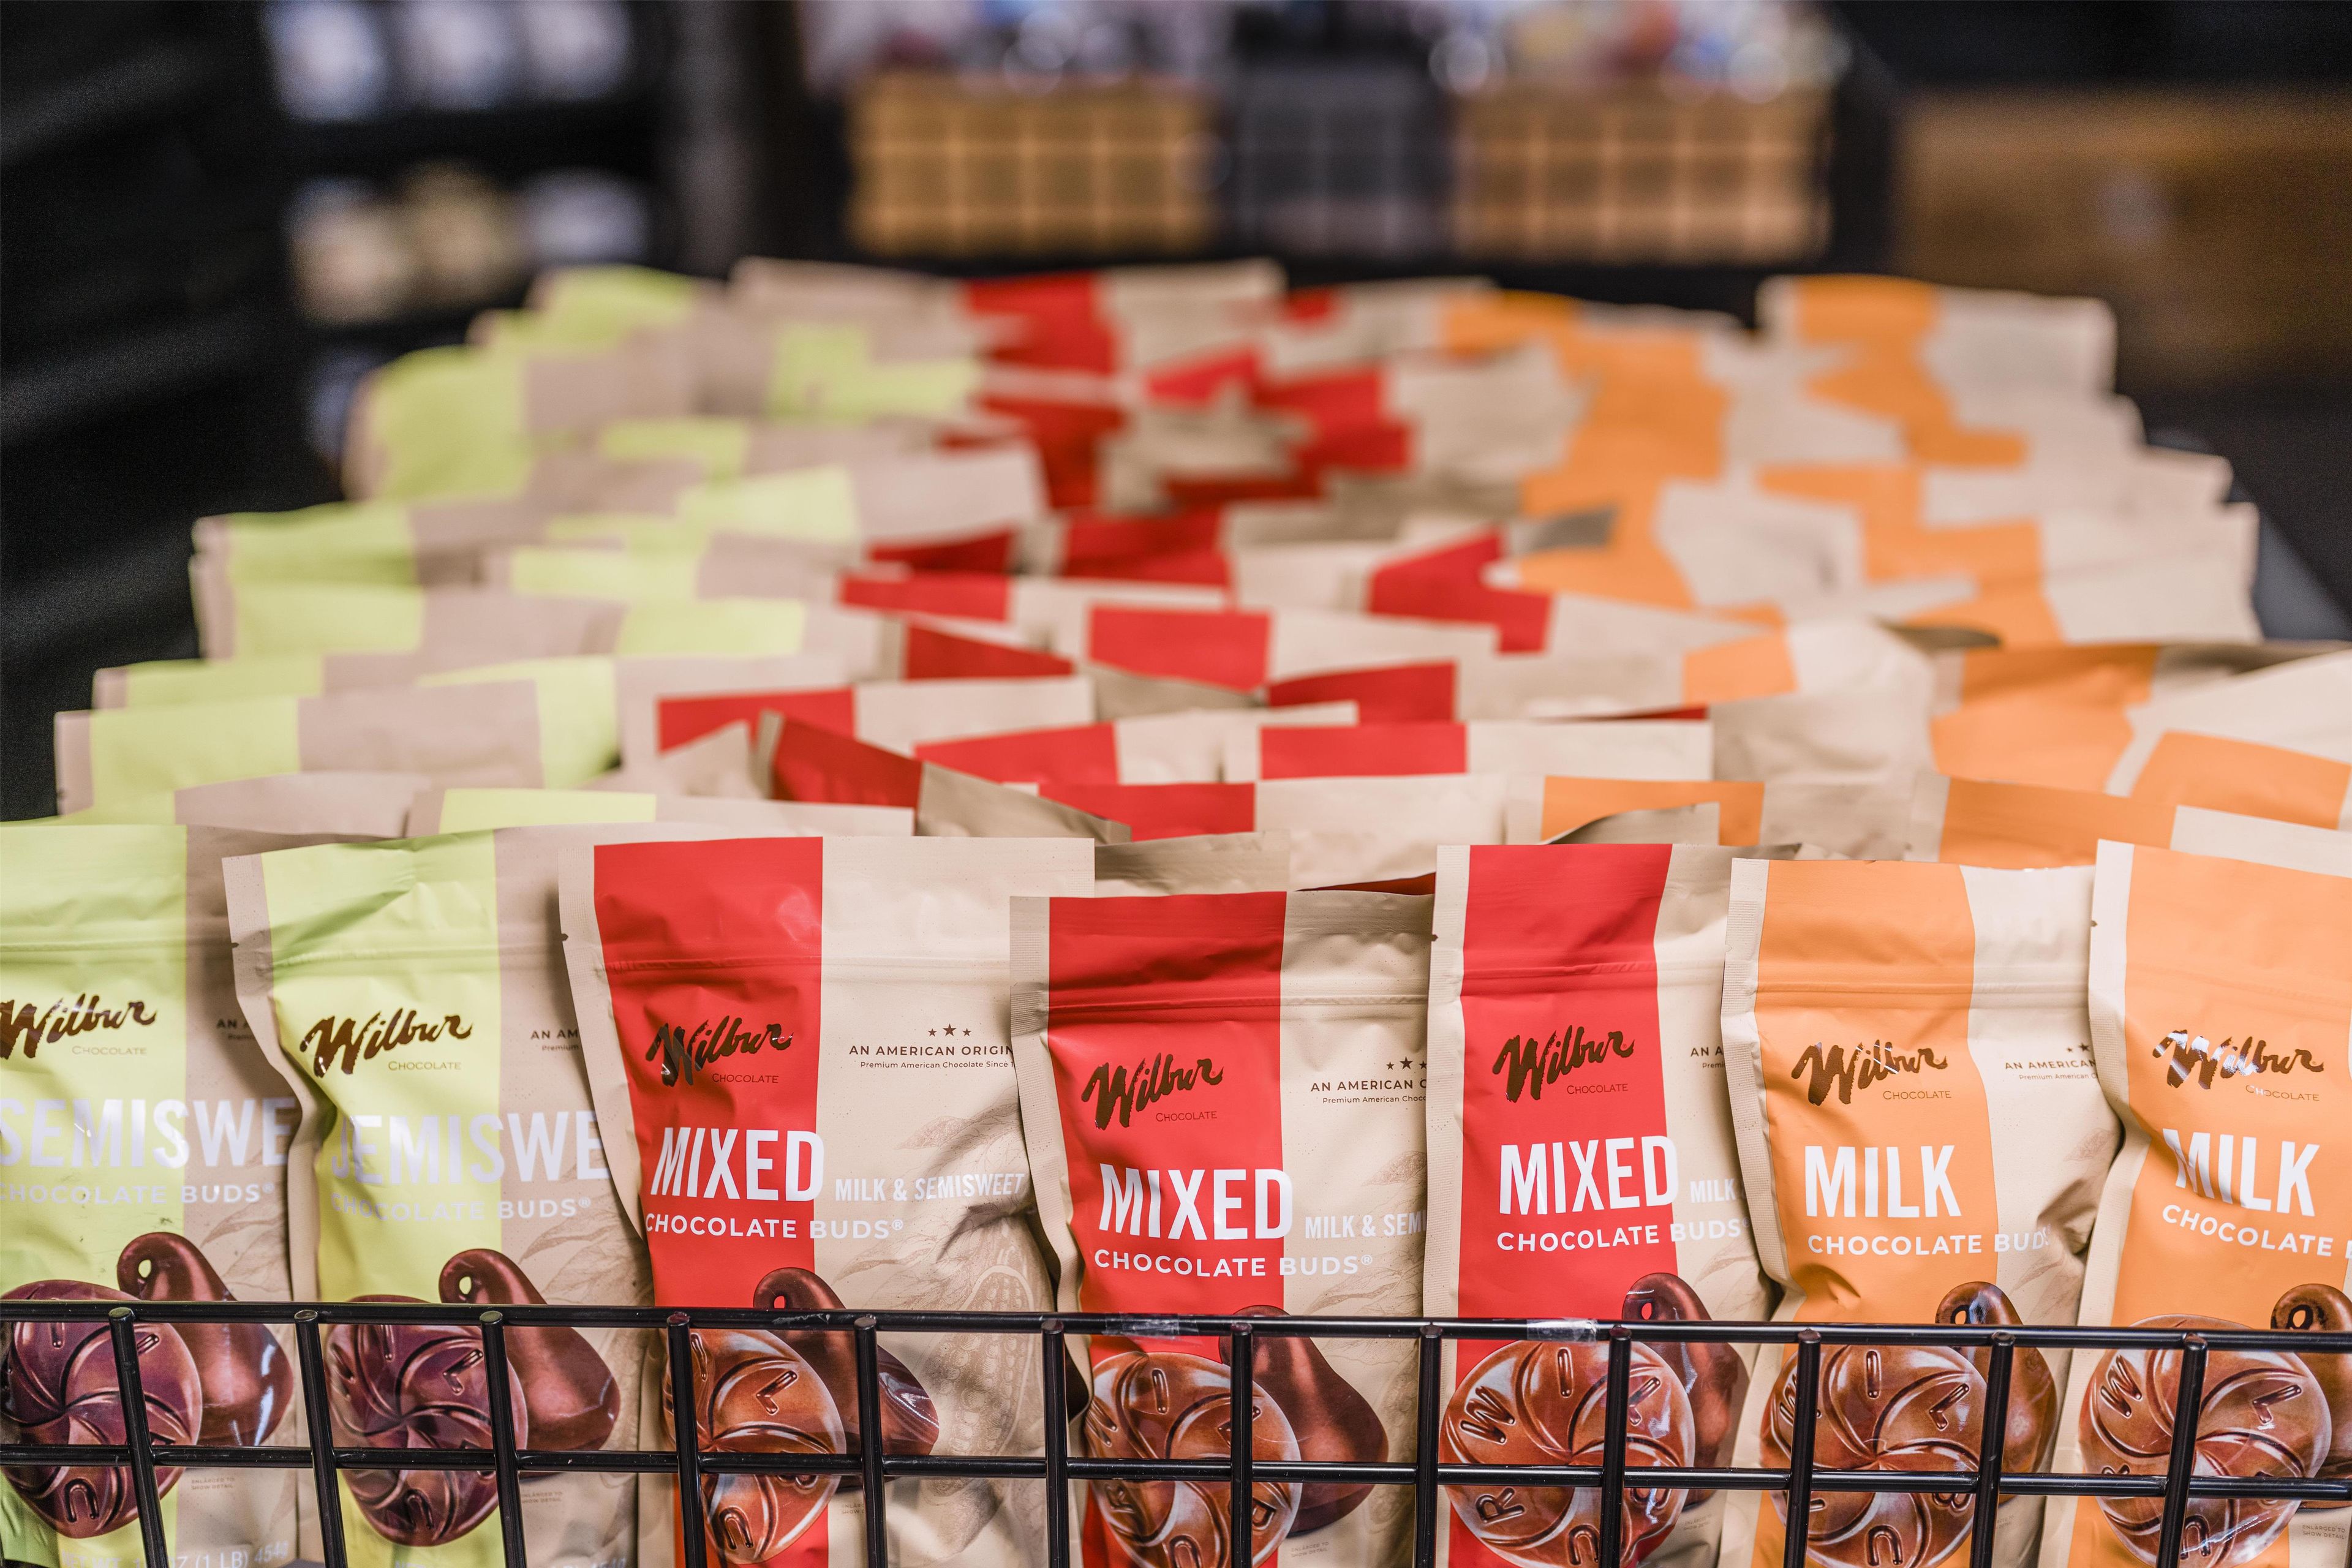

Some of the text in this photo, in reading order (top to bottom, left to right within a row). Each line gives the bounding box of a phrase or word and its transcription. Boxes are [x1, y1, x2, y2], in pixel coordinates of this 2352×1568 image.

[216, 1018, 237, 1028] AN
[530, 1030, 550, 1039] AN
[72, 1046, 148, 1056] CHOCOLATE
[300, 1007, 473, 1078] Wilbur
[645, 1015, 794, 1087] Wilbur
[849, 1046, 870, 1055] AN
[876, 1046, 955, 1055] AMERICAN
[1690, 1046, 1709, 1057] AN
[388, 1061, 461, 1071] CHOCOLATE
[1491, 1025, 1635, 1103] Wilbur
[1791, 1039, 1949, 1106] Wilbur
[2029, 1060, 2096, 1069] AMERICAN
[2152, 1029, 2324, 1090] Wilbur
[712, 1072, 778, 1084] CHOCOLATE
[1082, 1052, 1224, 1130] Wilbur
[1311, 1082, 1331, 1091] AN
[1337, 1080, 1413, 1091] AMERICAN
[1567, 1084, 1628, 1095] CHOCOLATE
[1883, 1090, 1951, 1101] CHOCOLATE
[2245, 1085, 2320, 1101] CHOCOLATE
[1155, 1110, 1218, 1122] CHOCOLATE
[650, 1126, 1025, 1202] MIXED MILK & SEMISWEET
[1499, 1136, 1736, 1216] MIXED MILK
[2163, 1128, 2320, 1217] MILK
[1804, 1145, 1961, 1218] MILK
[331, 1193, 484, 1221] CHOCOLATE
[1099, 1163, 1292, 1240] MIXED
[1305, 1215, 1355, 1238] MILK
[1361, 1215, 1376, 1237] &
[646, 1213, 796, 1238] CHOCOLATE
[1497, 1224, 1659, 1252] CHOCOLATE
[2162, 1204, 2334, 1257] CHOCOLATE
[1807, 1234, 1981, 1256] CHOCOLATE
[1095, 1249, 1266, 1277] CHOCOLATE
